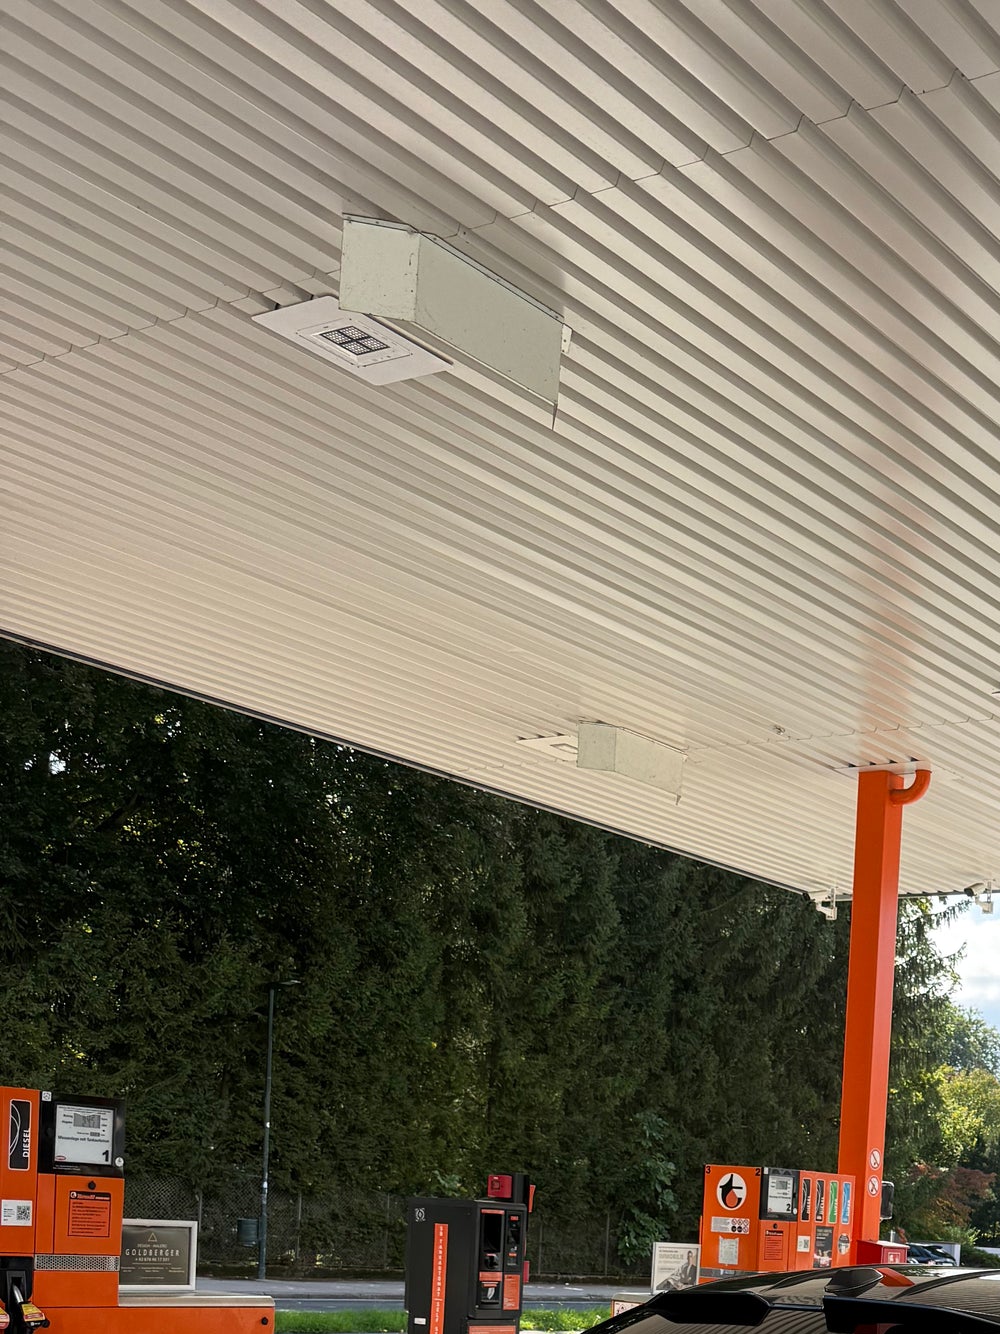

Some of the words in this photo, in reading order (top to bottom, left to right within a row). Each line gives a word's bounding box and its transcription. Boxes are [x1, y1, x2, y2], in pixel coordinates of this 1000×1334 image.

[22, 1129, 31, 1158] DIESEL
[102, 1150, 109, 1162] 1
[705, 1166, 711, 1174] 3
[755, 1168, 761, 1176] 2
[786, 1203, 791, 1212] 2
[125, 1248, 180, 1257] GOLDBERGER
